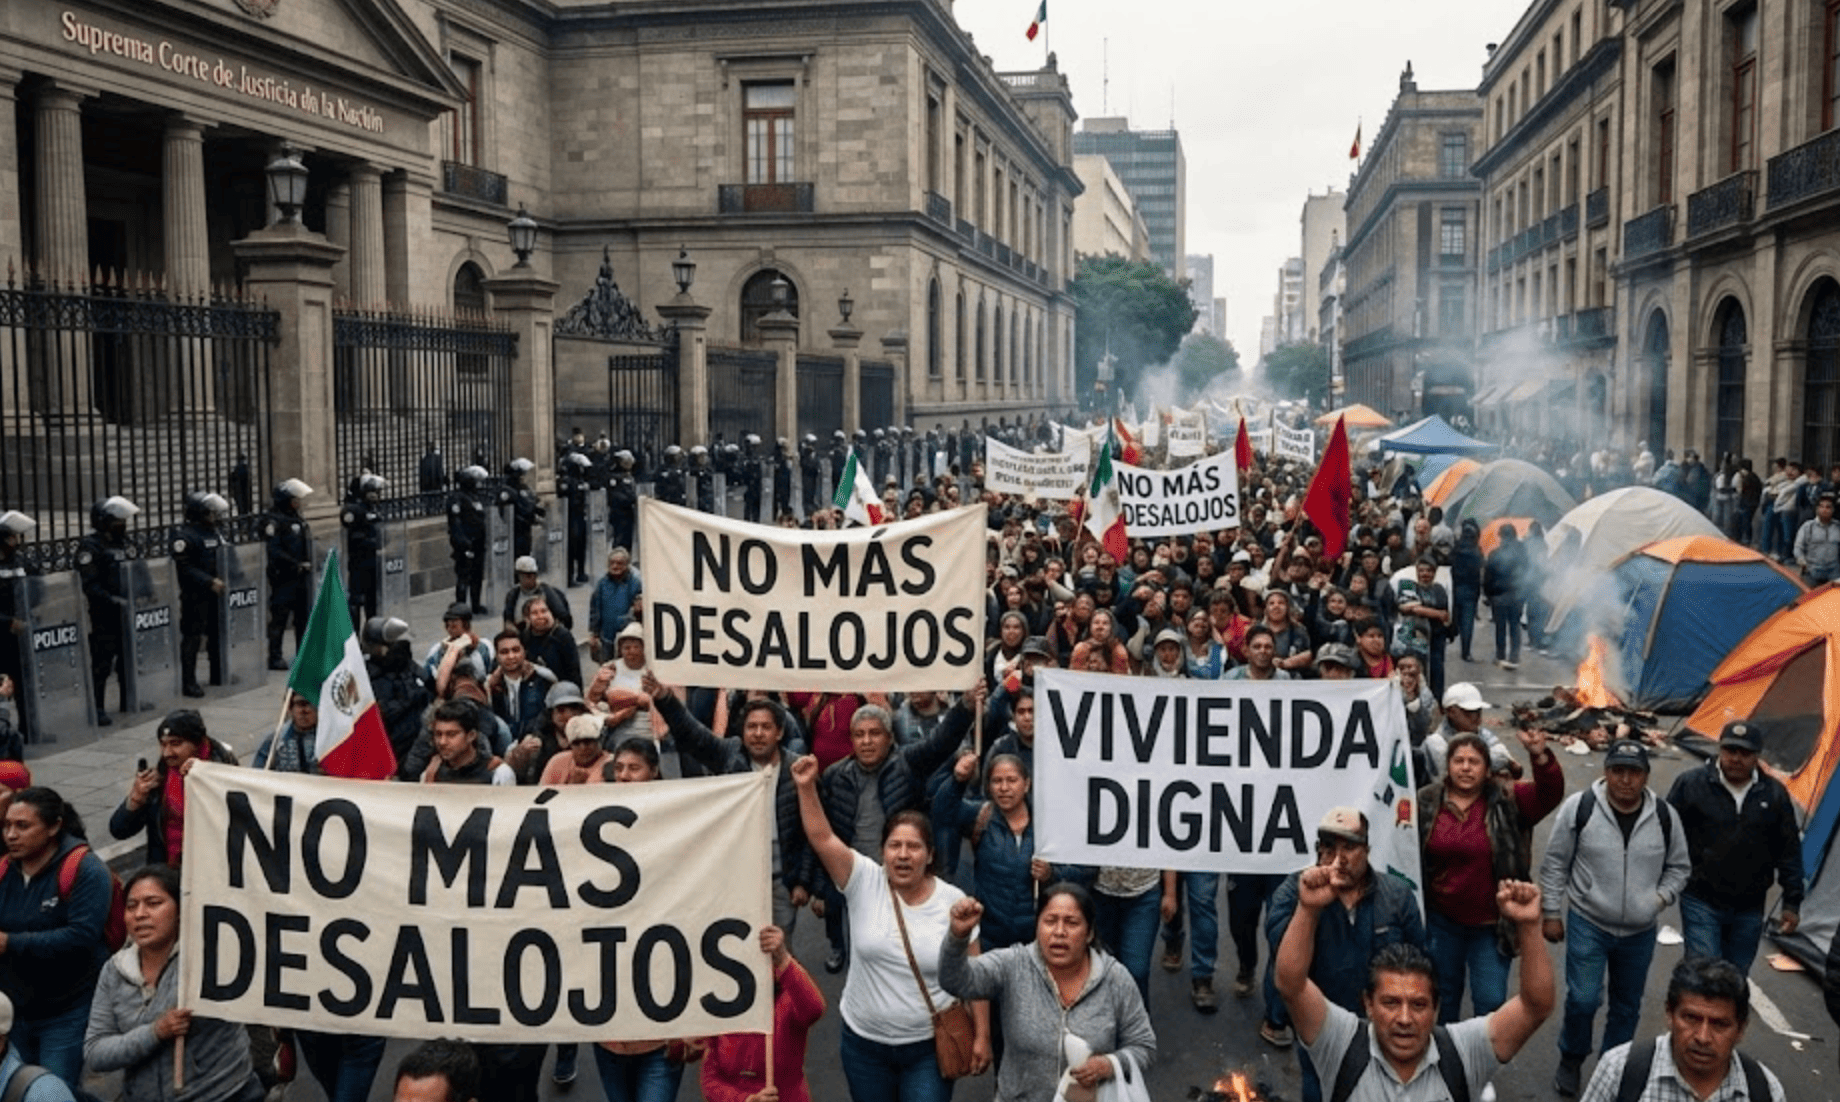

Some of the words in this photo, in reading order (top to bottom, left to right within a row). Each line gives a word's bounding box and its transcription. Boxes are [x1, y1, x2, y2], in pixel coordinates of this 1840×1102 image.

[62, 11, 153, 64] Suprema
[159, 41, 209, 82] Corte
[213, 59, 234, 88] de
[239, 65, 297, 109] Justicia
[321, 92, 335, 119] la
[1117, 470, 1152, 498] NO
[1163, 463, 1220, 498] MÁS
[1121, 493, 1236, 527] DESALOJOS
[692, 531, 778, 595] NO
[801, 528, 936, 597] MÁS
[33, 625, 77, 650] POLICE
[653, 602, 975, 670] DESALOJOS
[1047, 689, 1379, 769] VIVIENDA
[225, 791, 367, 899] NO
[408, 788, 641, 908] MÁS
[1087, 777, 1308, 854] DIGNA
[200, 904, 757, 1027] DESALOJOS
